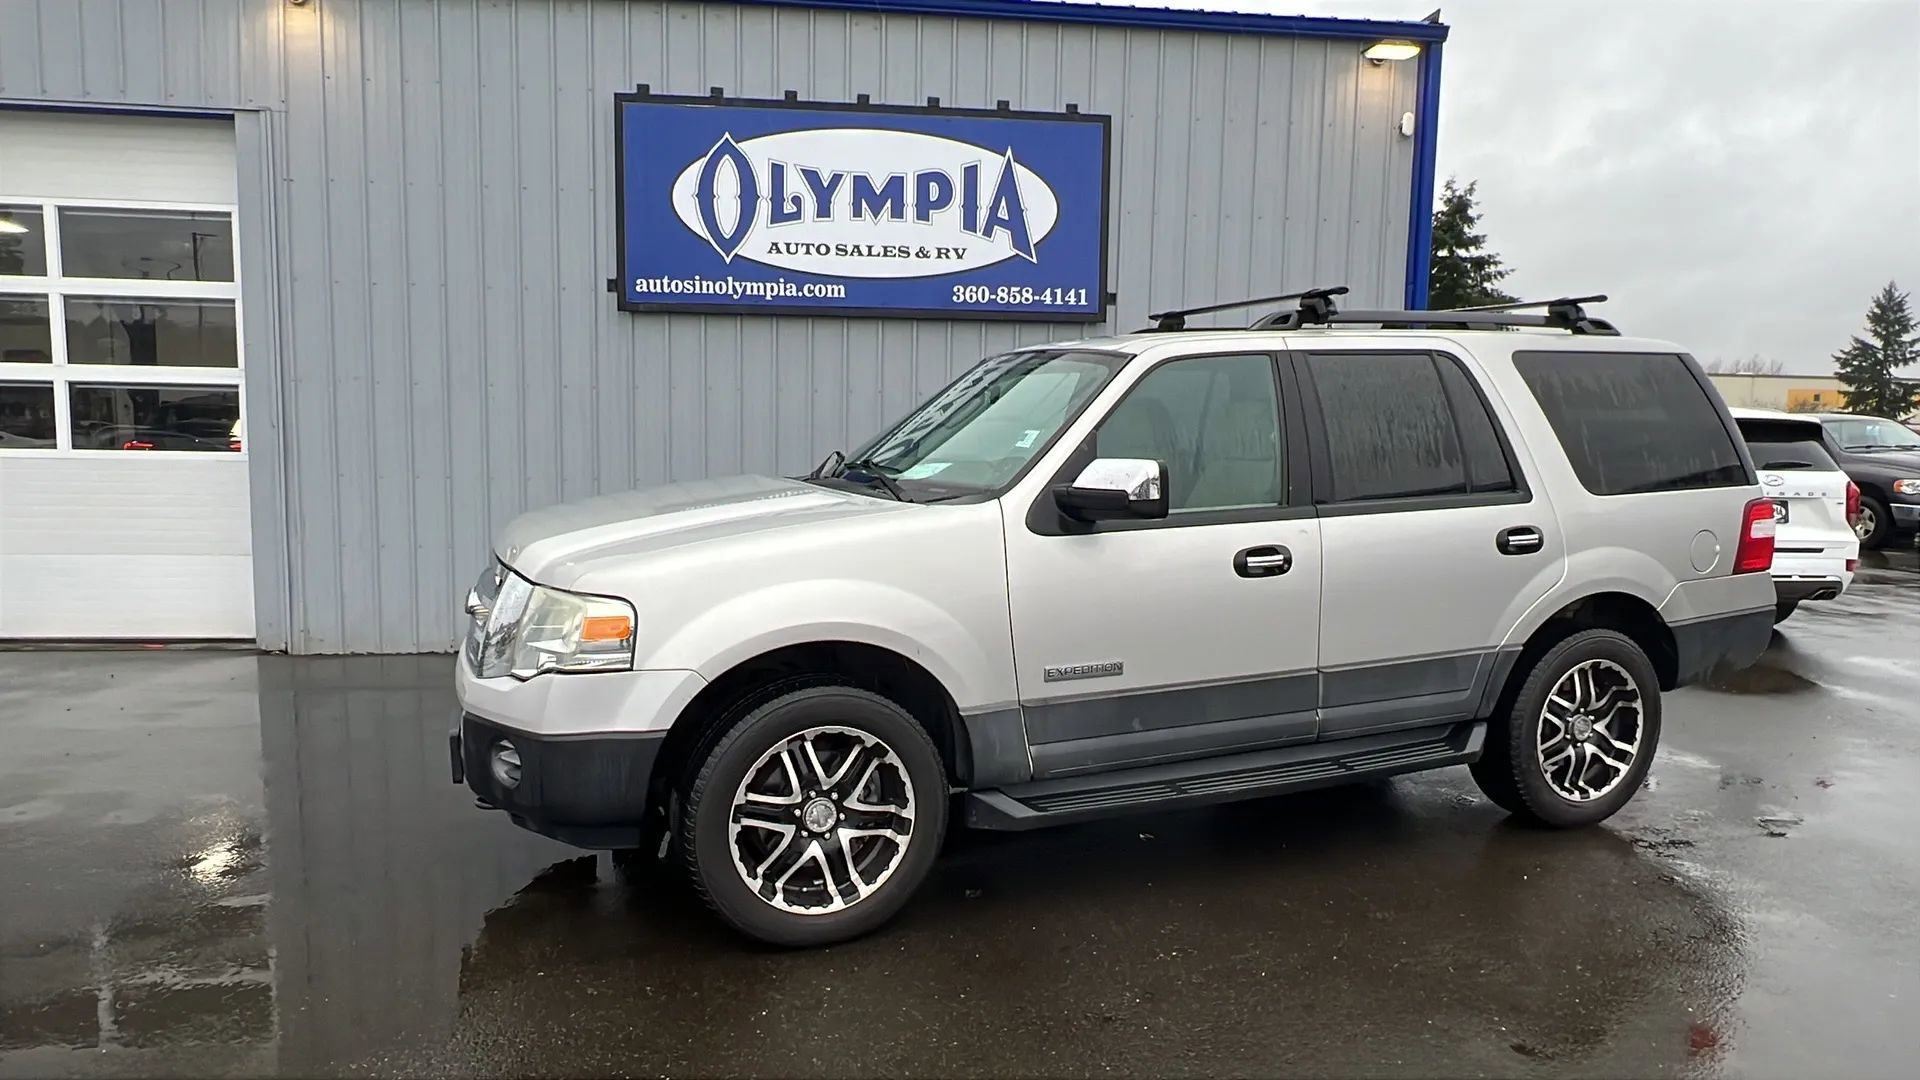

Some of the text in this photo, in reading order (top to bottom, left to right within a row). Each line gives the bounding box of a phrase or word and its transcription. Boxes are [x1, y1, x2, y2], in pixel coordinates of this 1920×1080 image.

[693, 131, 1037, 264] OLYMPIA
[767, 242, 967, 260] AUTO SALES & RV
[635, 275, 846, 300] autosinolympia.com
[952, 285, 1088, 306] 360-858-4141
[1047, 662, 1123, 677] EXPEDITION
